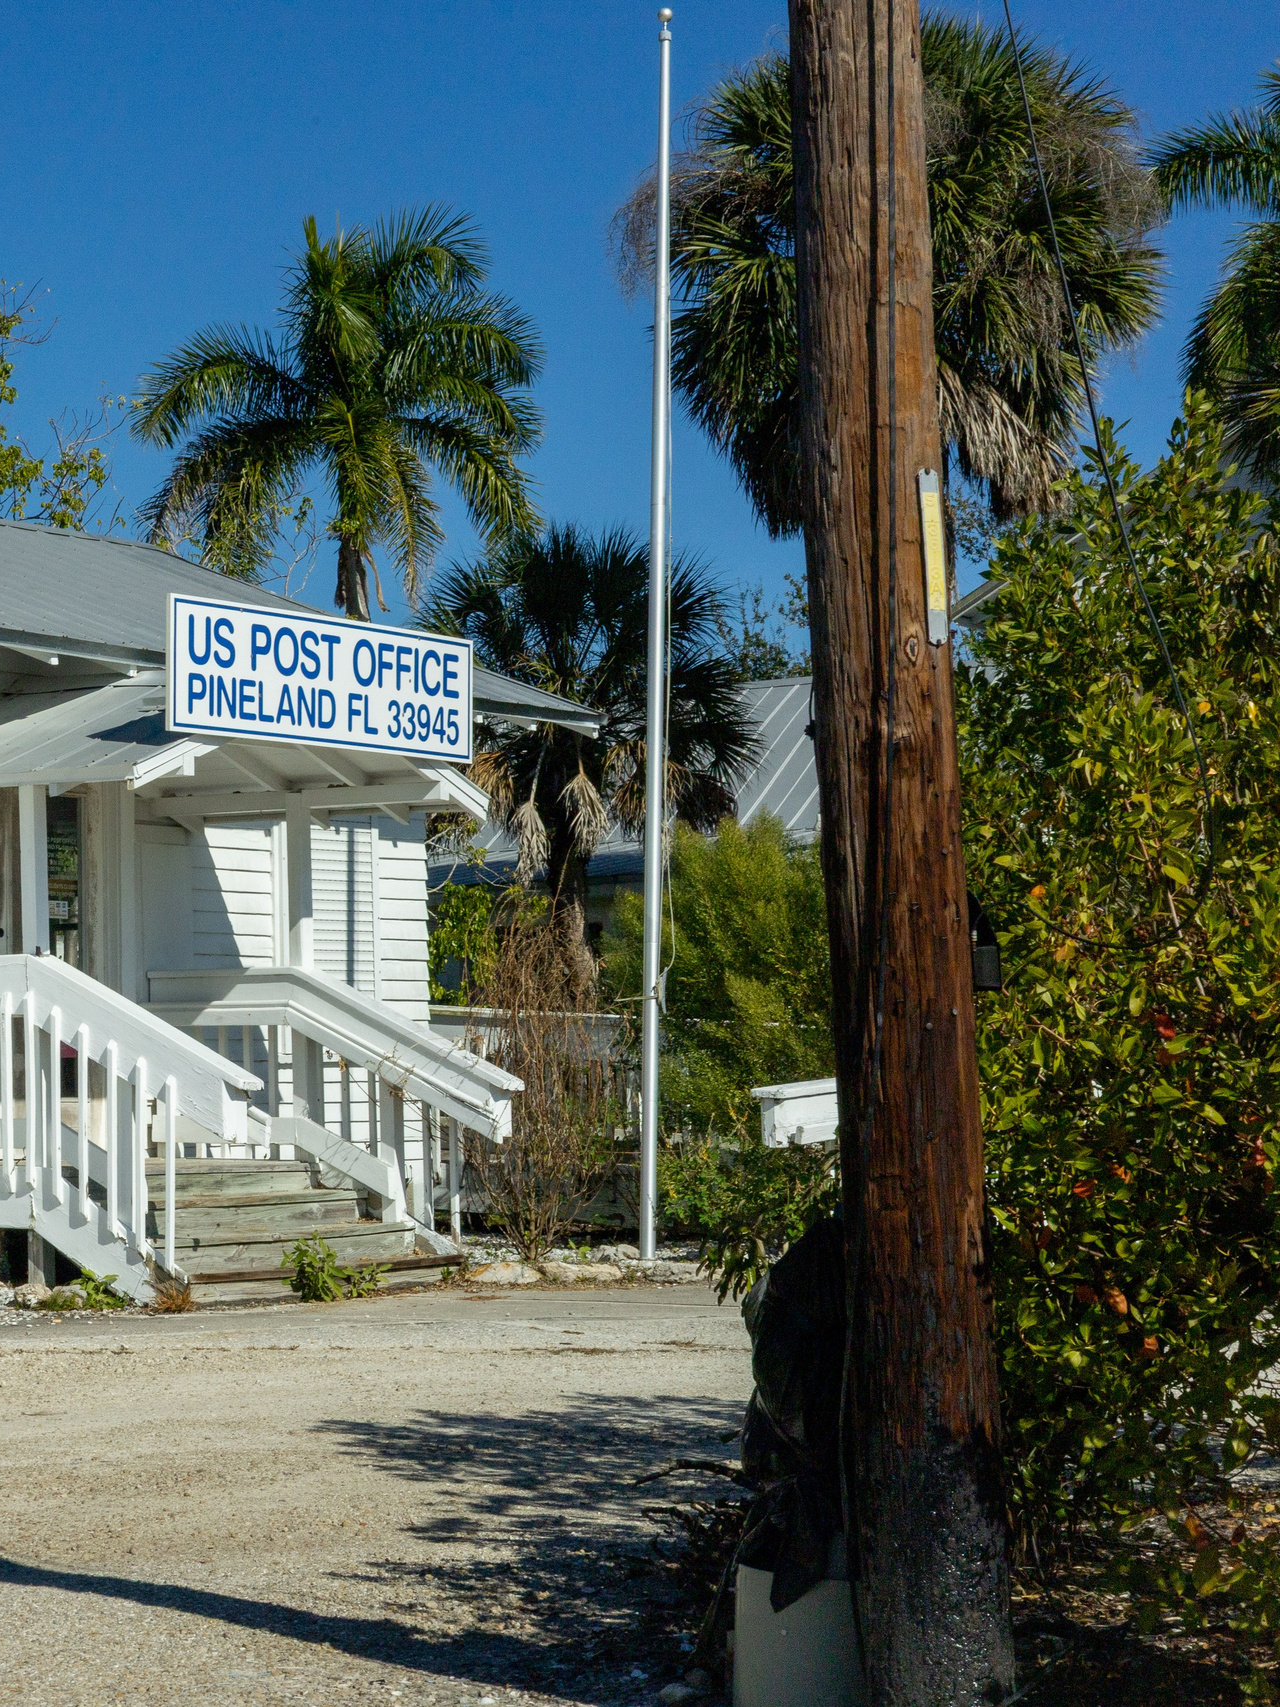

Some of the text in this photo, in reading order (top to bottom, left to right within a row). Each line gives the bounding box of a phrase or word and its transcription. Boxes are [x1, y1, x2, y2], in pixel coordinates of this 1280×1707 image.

[188, 614, 459, 699] US POST OFFICE
[188, 672, 459, 746] PINELAND FL 33945
